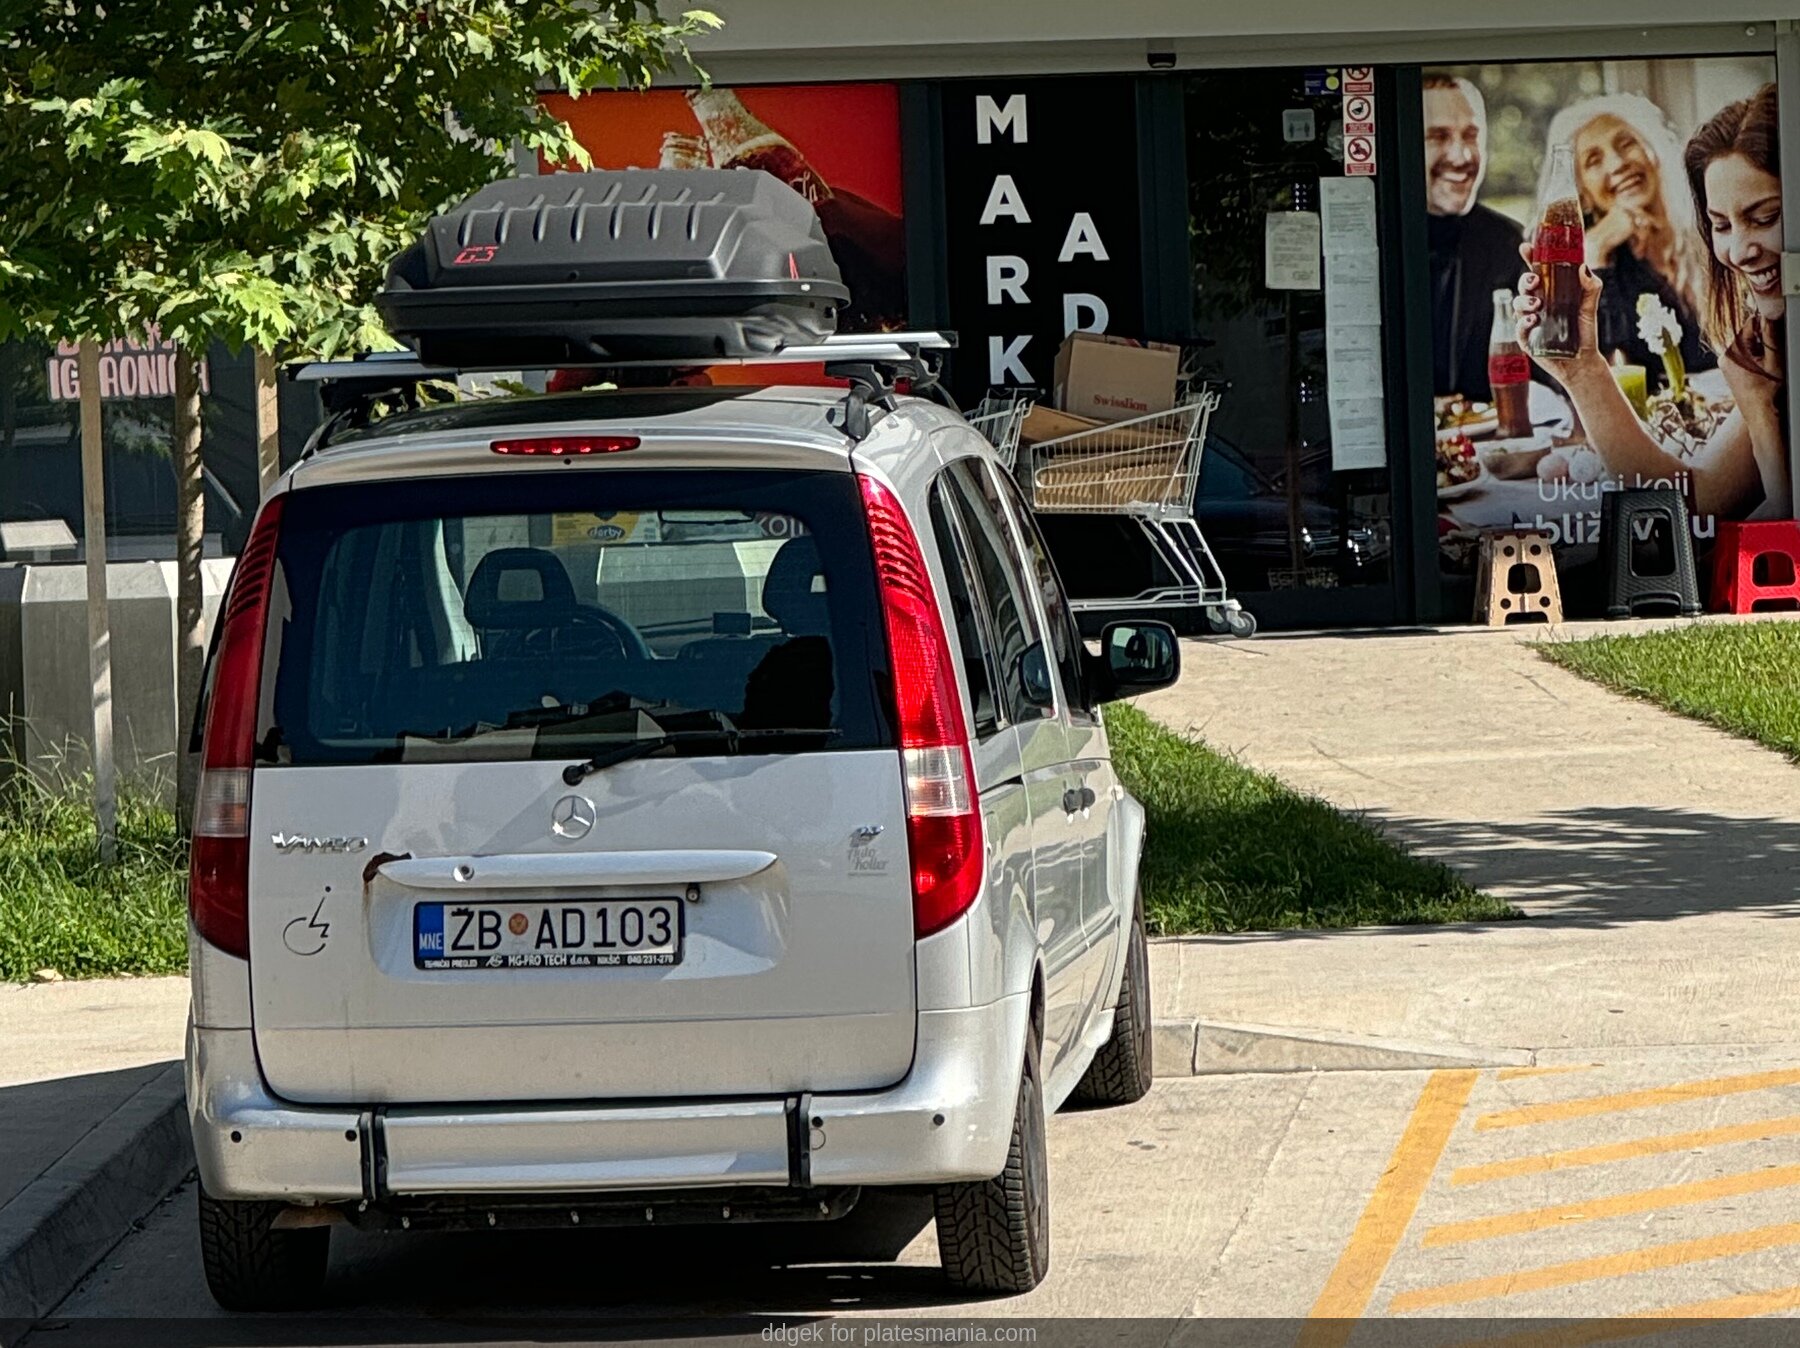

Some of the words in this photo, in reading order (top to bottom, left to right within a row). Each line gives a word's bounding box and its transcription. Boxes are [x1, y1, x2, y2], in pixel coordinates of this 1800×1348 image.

[976, 94, 1035, 385] MARK
[48, 353, 210, 400] IGAONIA
[1093, 394, 1148, 411] Swisslion
[1538, 474, 1625, 502] Ukusi
[419, 932, 443, 951] MNE
[451, 907, 502, 951] ŽB
[535, 906, 672, 949] AD103
[544, 953, 567, 966] TECH
